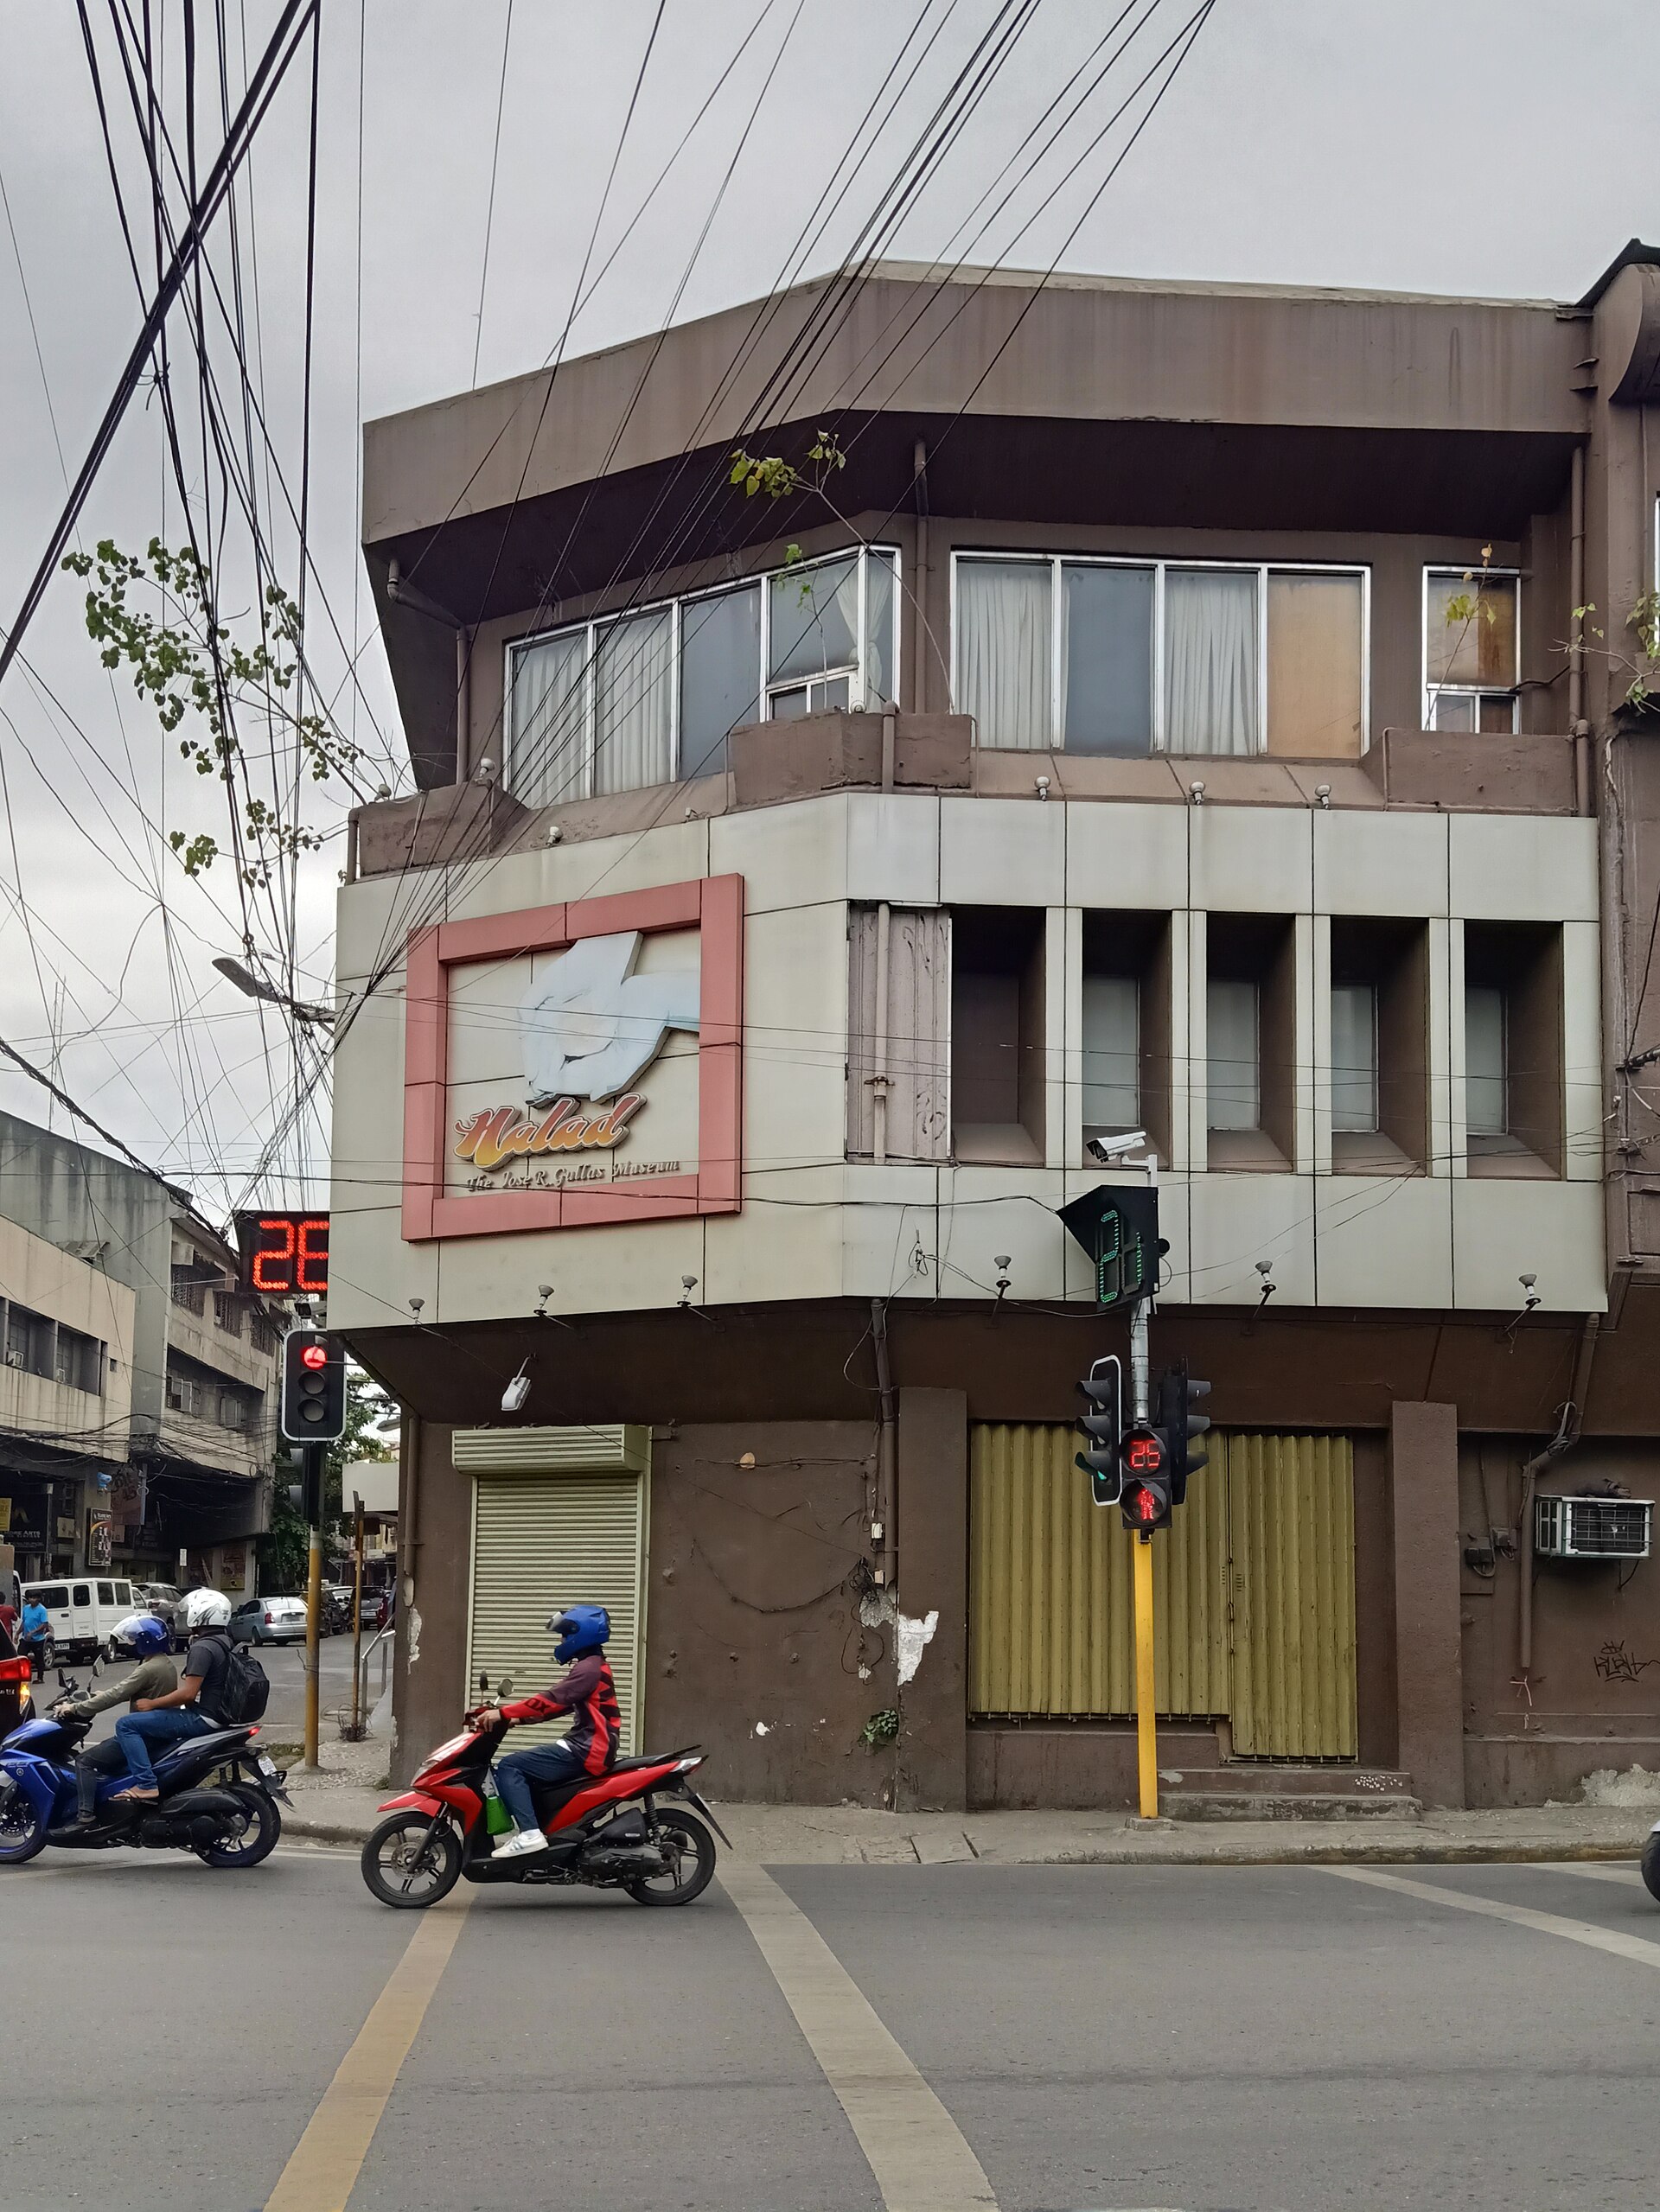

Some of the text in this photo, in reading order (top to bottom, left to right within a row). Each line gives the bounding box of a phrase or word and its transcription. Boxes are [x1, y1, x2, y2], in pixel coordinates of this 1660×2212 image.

[454, 1093, 647, 1171] Halad
[466, 1176, 492, 1192] The
[502, 1172, 531, 1188] Jose
[553, 1164, 605, 1189] Gullas
[612, 1160, 680, 1177] Museum
